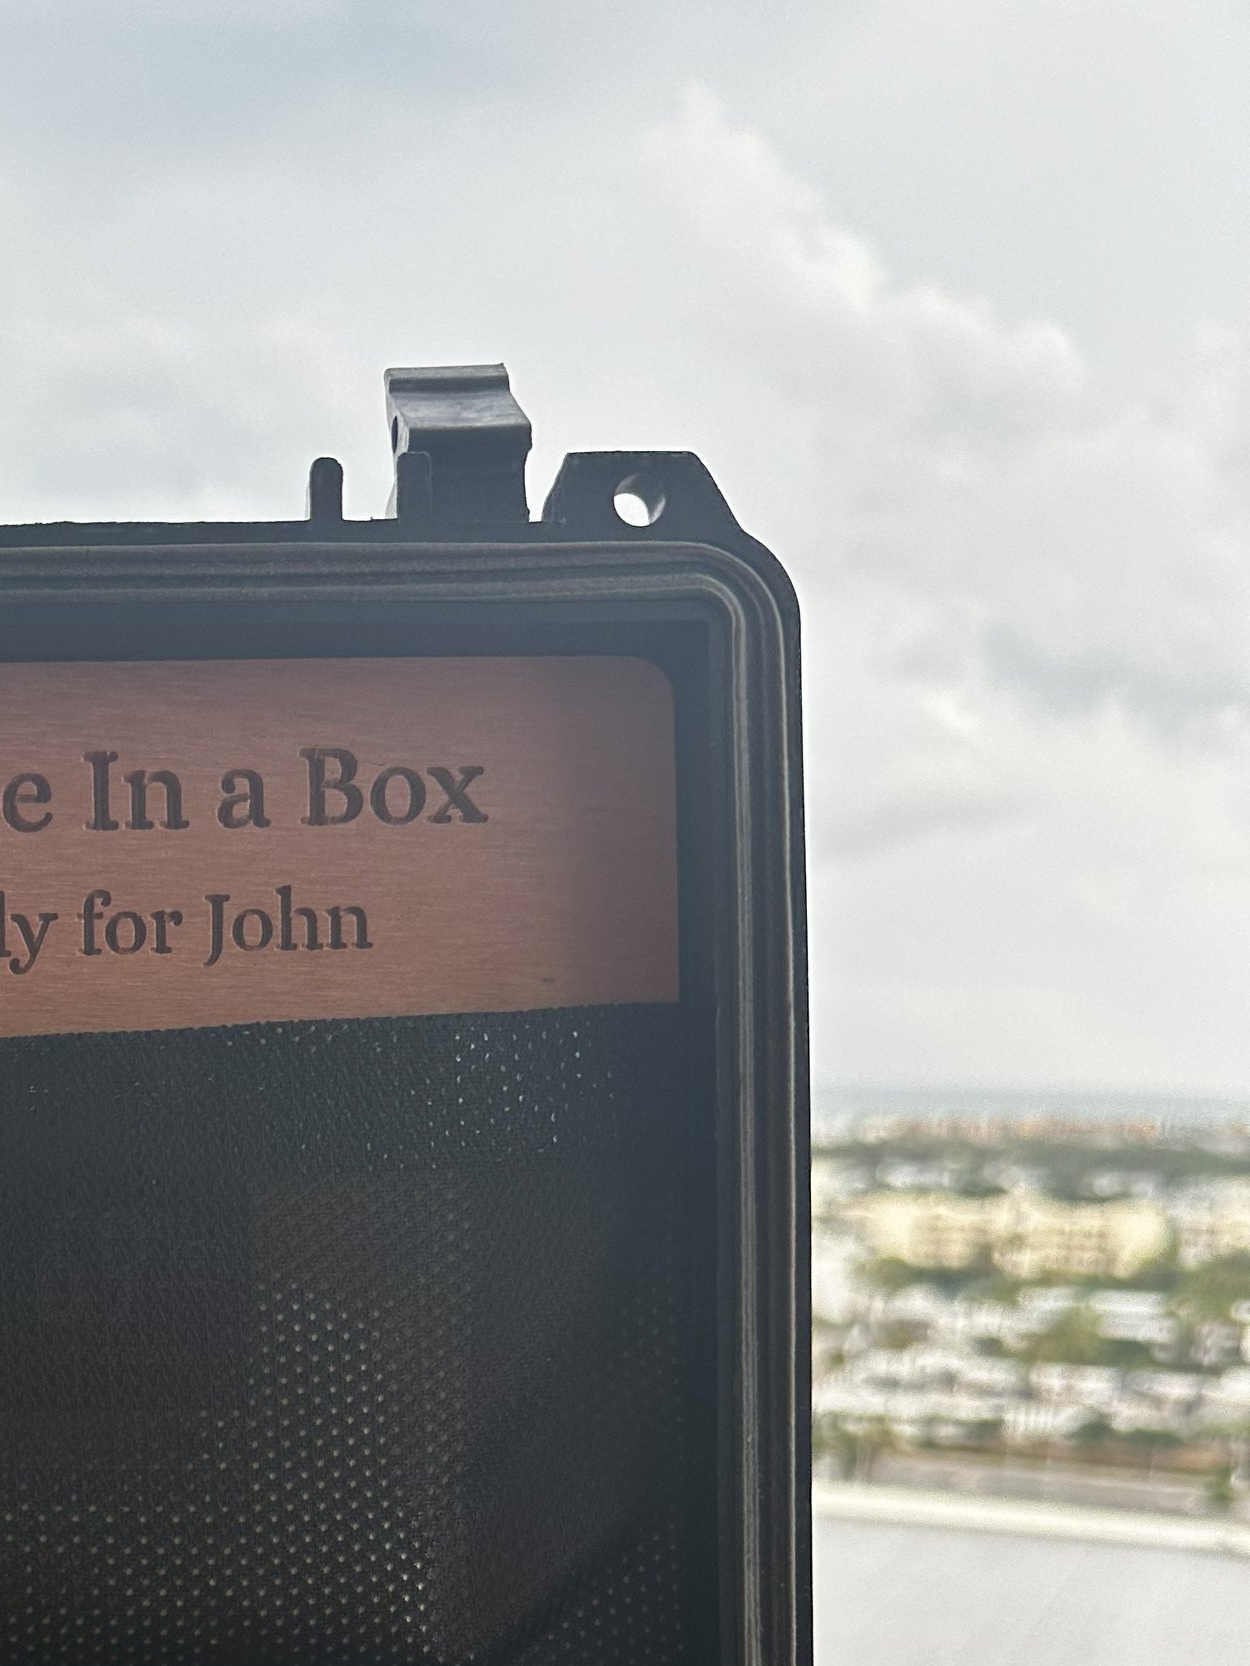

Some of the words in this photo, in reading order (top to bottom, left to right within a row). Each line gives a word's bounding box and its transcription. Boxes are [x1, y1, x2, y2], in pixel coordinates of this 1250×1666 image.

[83, 749, 191, 832] In
[218, 770, 271, 829] a
[300, 747, 489, 826] Box
[78, 888, 183, 958] for
[204, 885, 374, 967] John
